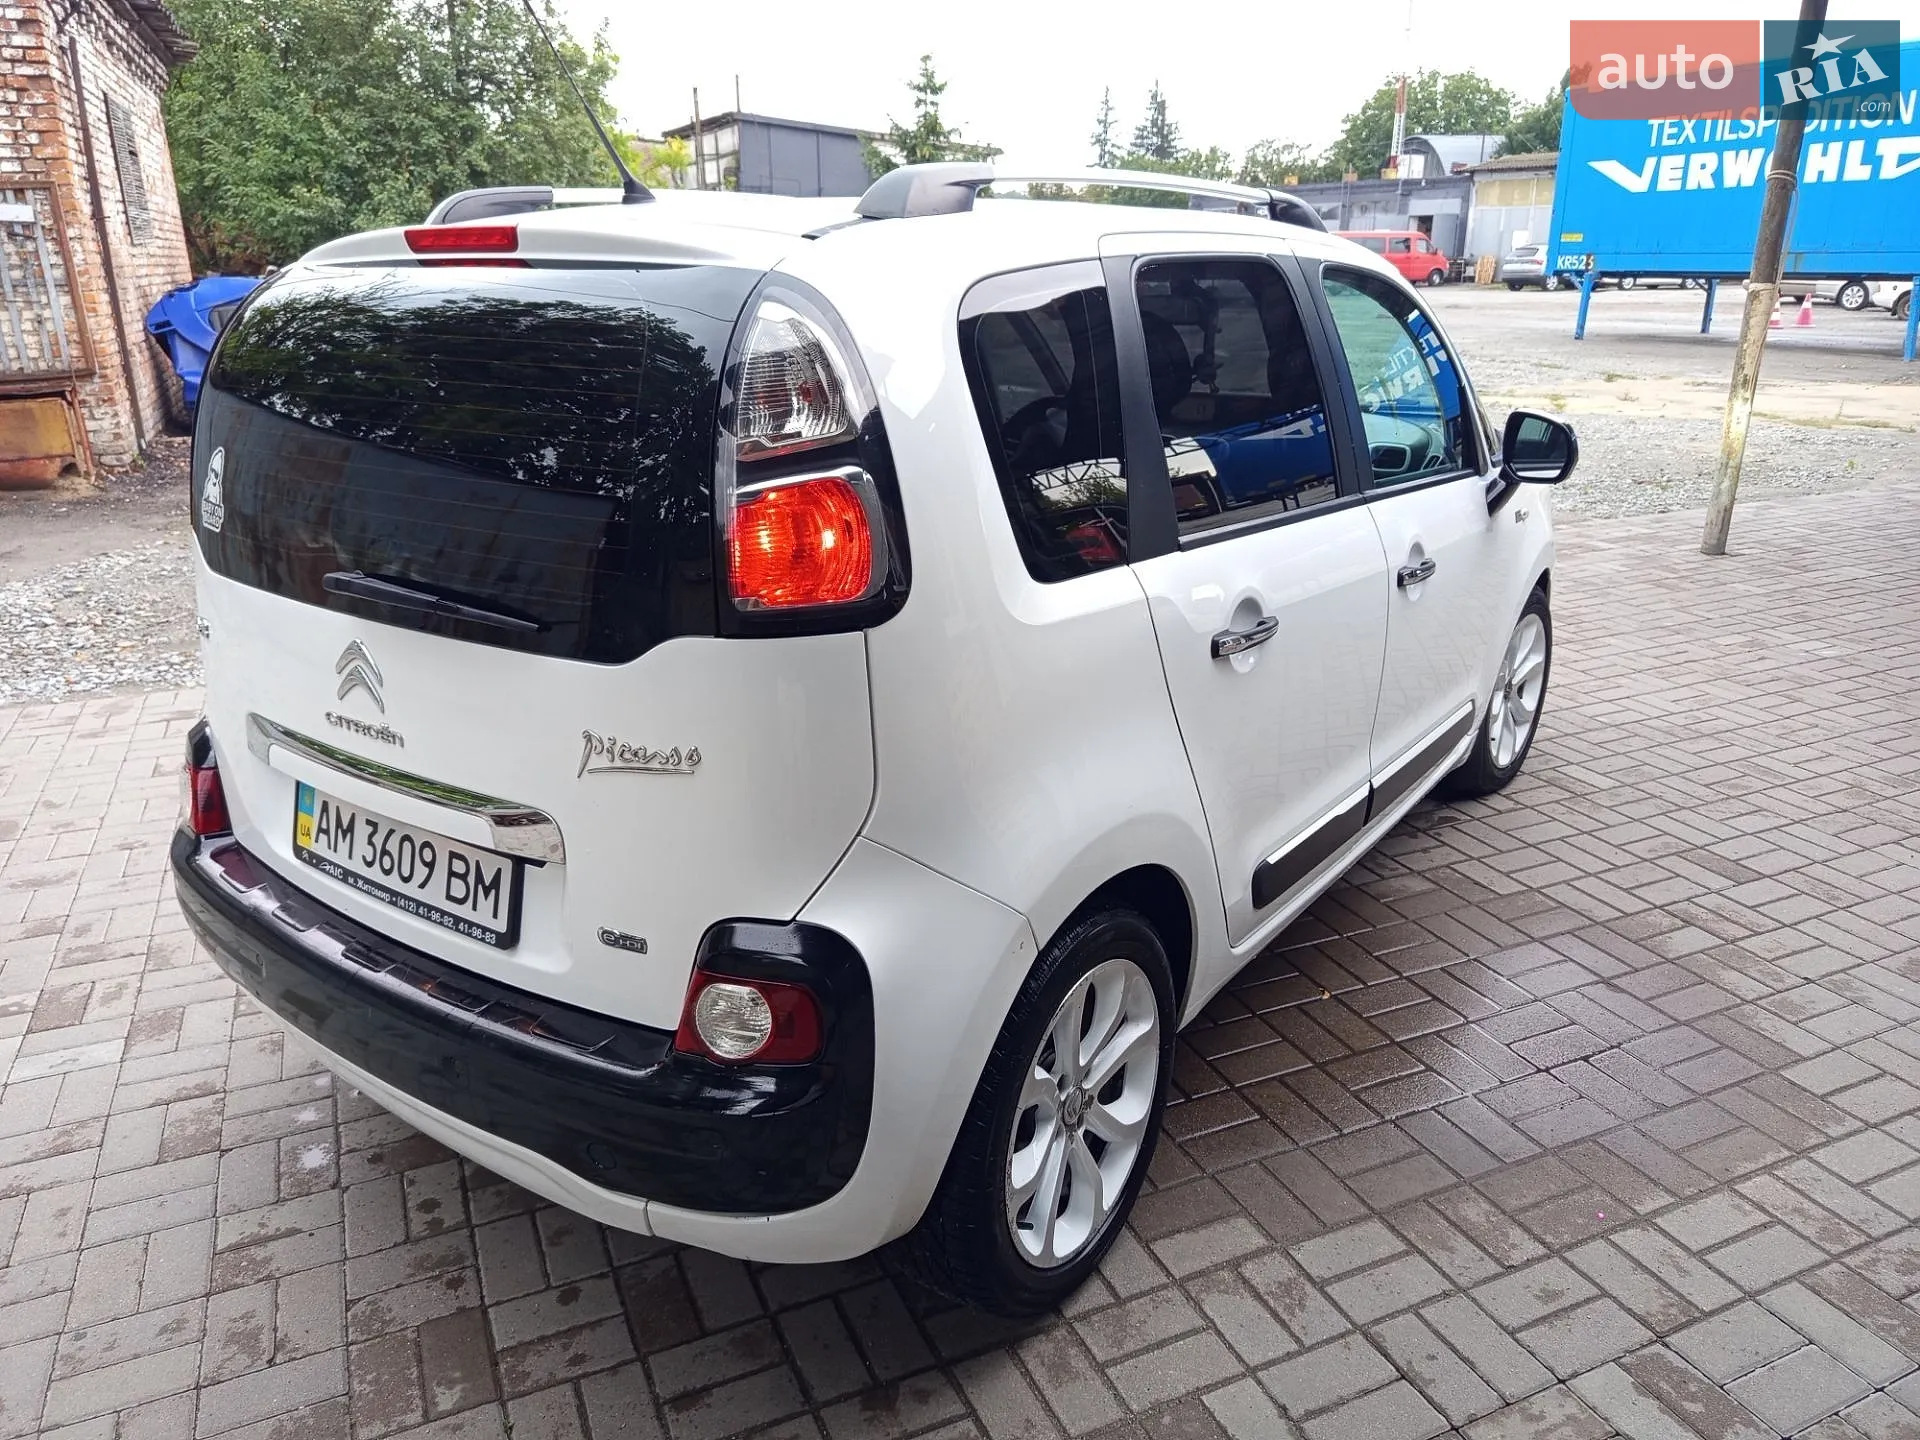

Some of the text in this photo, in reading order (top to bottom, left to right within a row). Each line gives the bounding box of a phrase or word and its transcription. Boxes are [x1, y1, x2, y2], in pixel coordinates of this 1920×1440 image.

[1647, 89, 1917, 148] TEXTILSPDITION
[577, 729, 702, 778] Picasso
[300, 824, 311, 840] UA
[315, 800, 502, 919] AM 3609 BM
[356, 877, 391, 903] Житомир
[397, 896, 417, 913] (412)
[458, 922, 496, 944] 41-96-83
